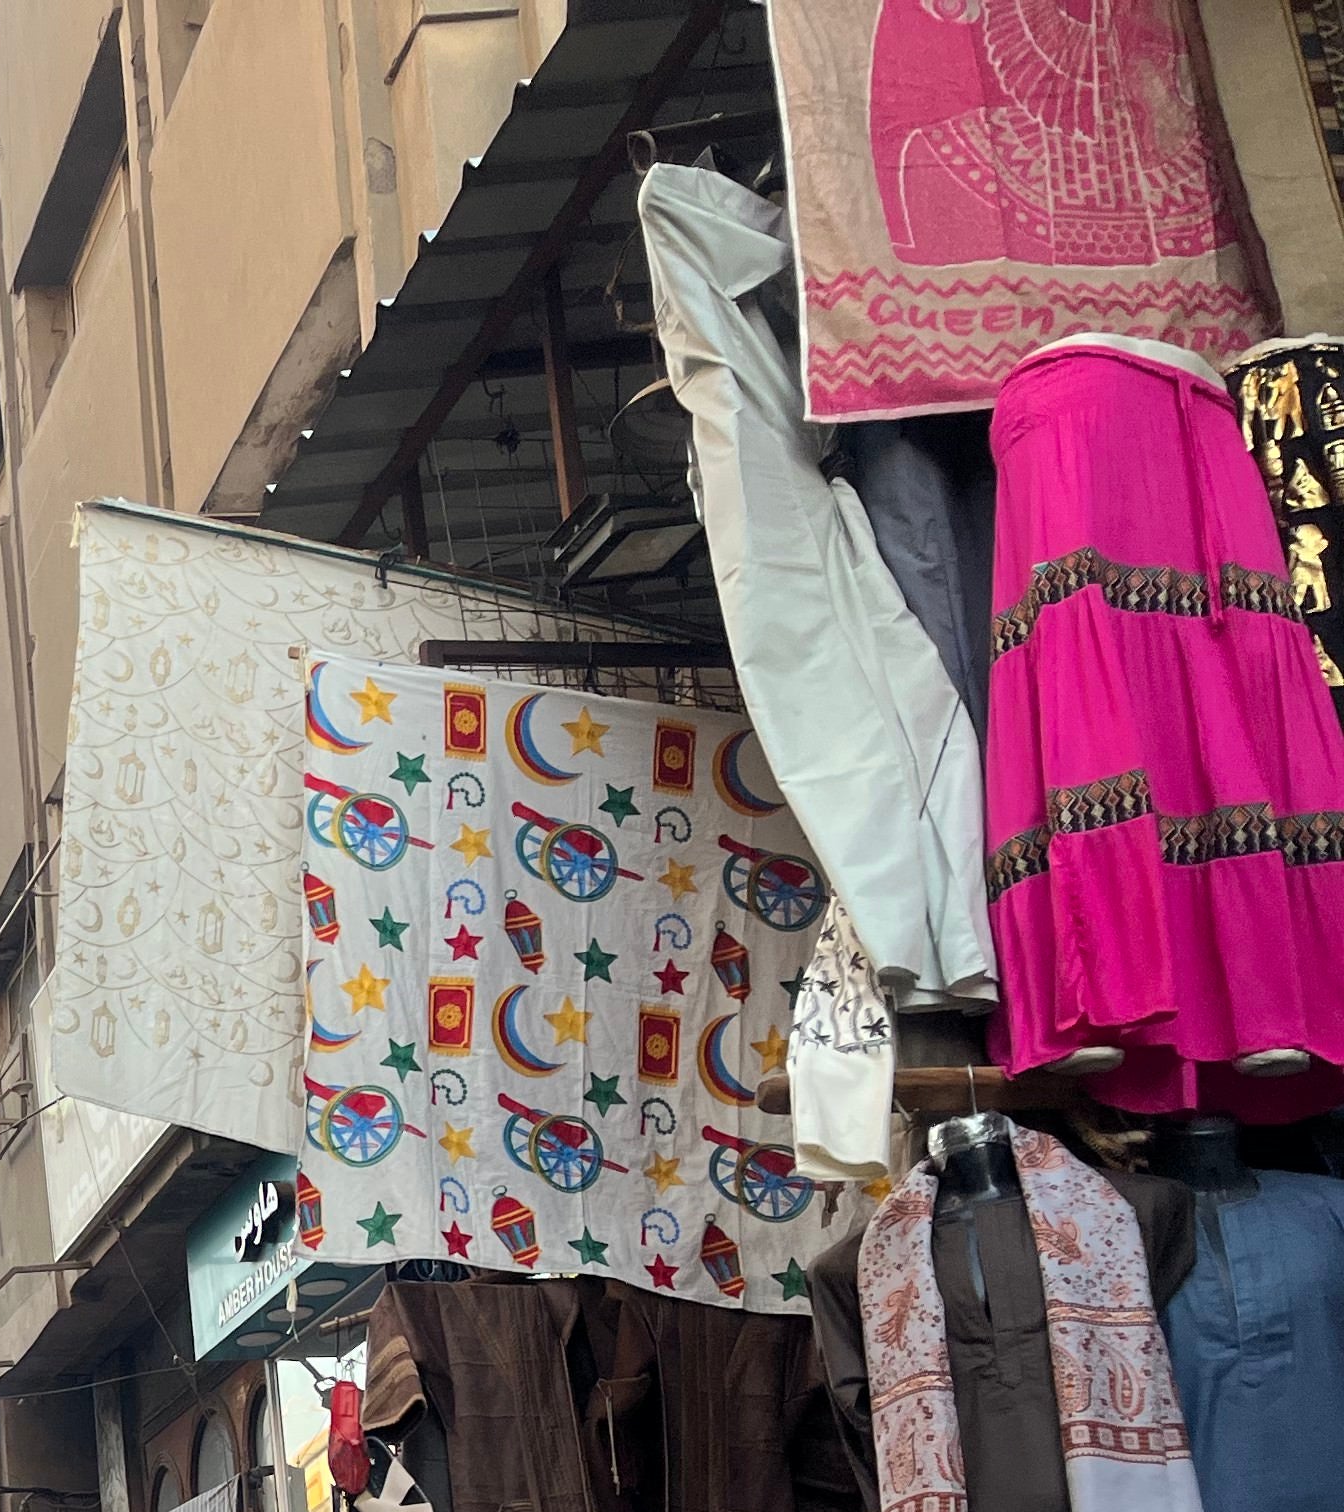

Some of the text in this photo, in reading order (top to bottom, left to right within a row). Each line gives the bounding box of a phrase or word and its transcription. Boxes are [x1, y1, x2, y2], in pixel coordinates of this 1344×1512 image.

[233, 1180, 279, 1263] هاوس
[218, 1239, 298, 1328] AMBER HOUSE
